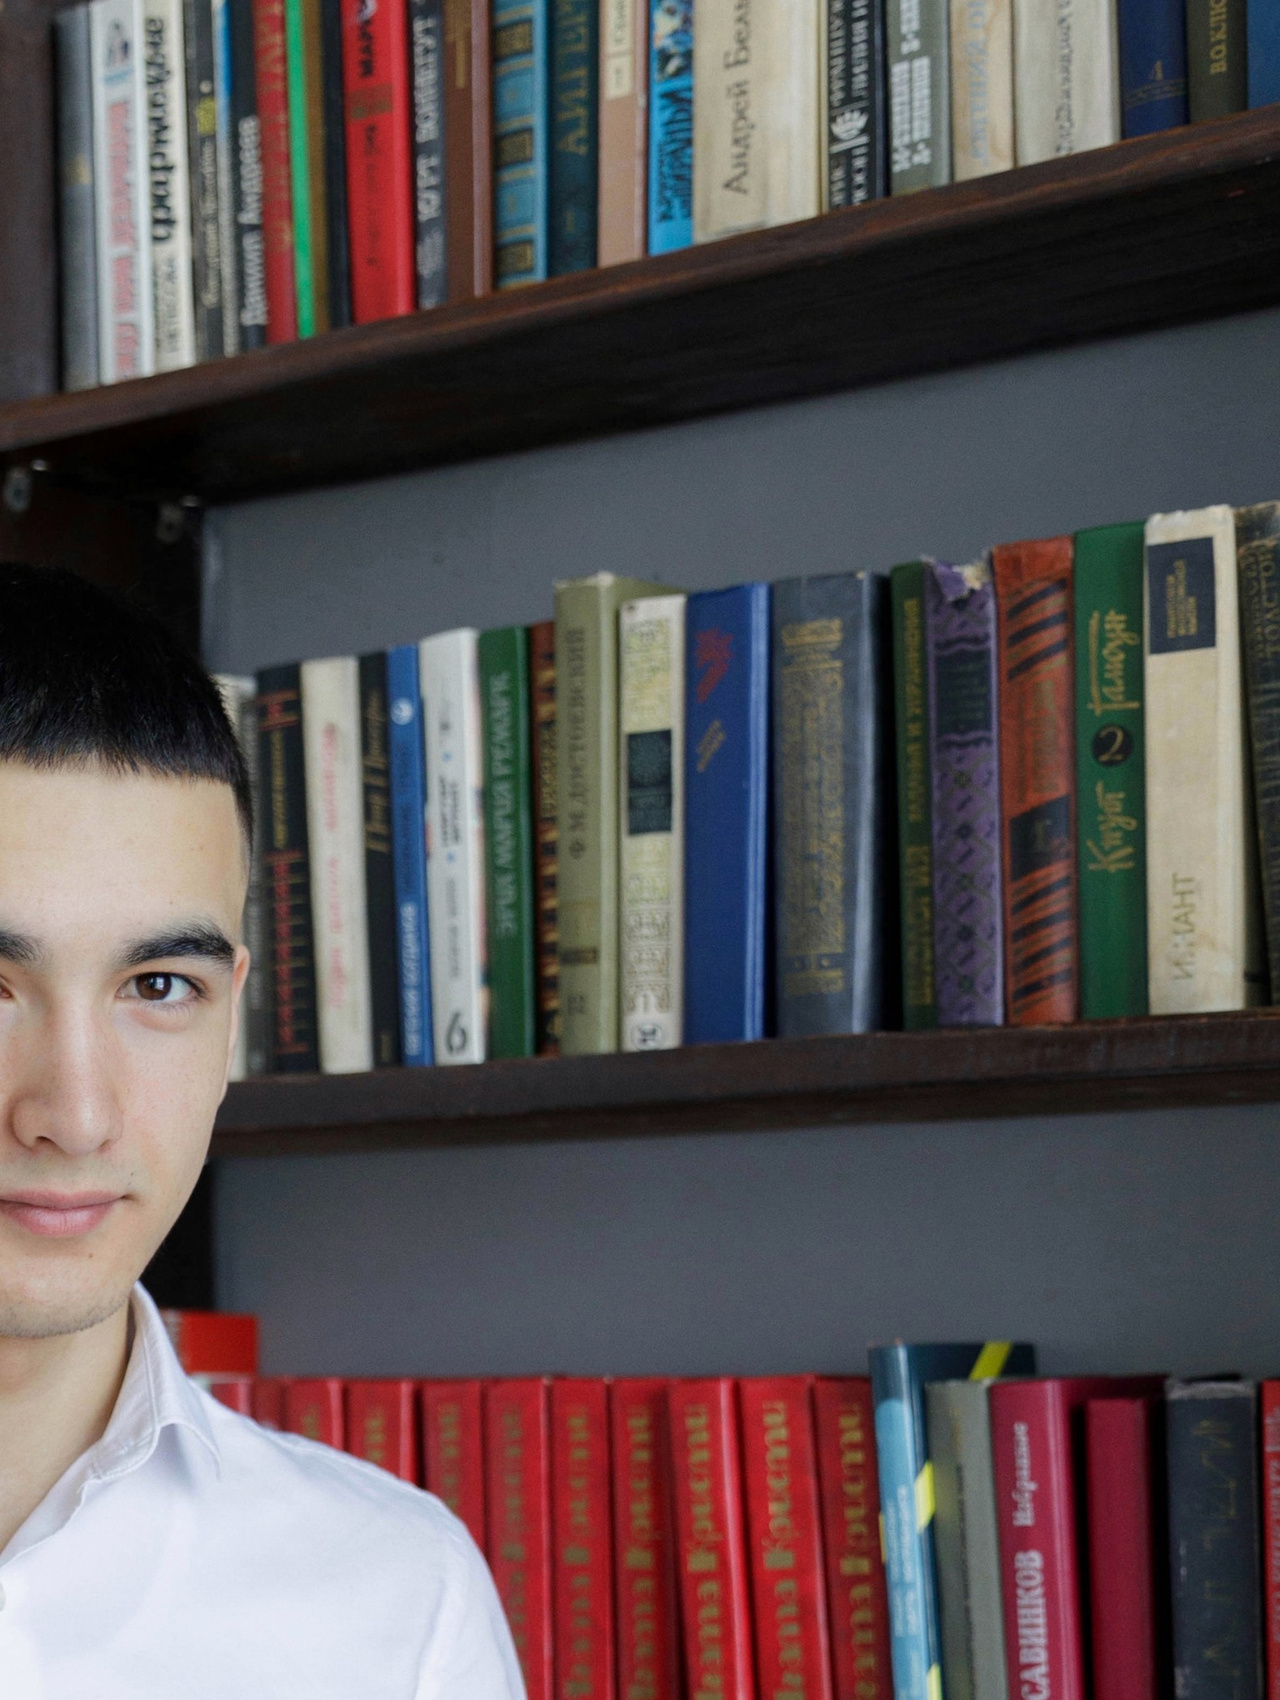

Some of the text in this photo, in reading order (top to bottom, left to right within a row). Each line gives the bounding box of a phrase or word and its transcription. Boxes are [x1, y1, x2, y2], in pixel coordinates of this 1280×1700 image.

[721, 80, 755, 195] Андрей
[567, 628, 587, 807] ДОСТОЕВСКИЙ
[1087, 610, 1140, 716] Гамсун
[1099, 726, 1124, 761] 2
[489, 672, 518, 937] ЭРИХ МАРИЯ РЕМАРК
[444, 1011, 468, 1056] 6
[683, 1406, 722, 1573] Кристи
[762, 1401, 801, 1572] Кристи
[1013, 1421, 1037, 1527] Избранное
